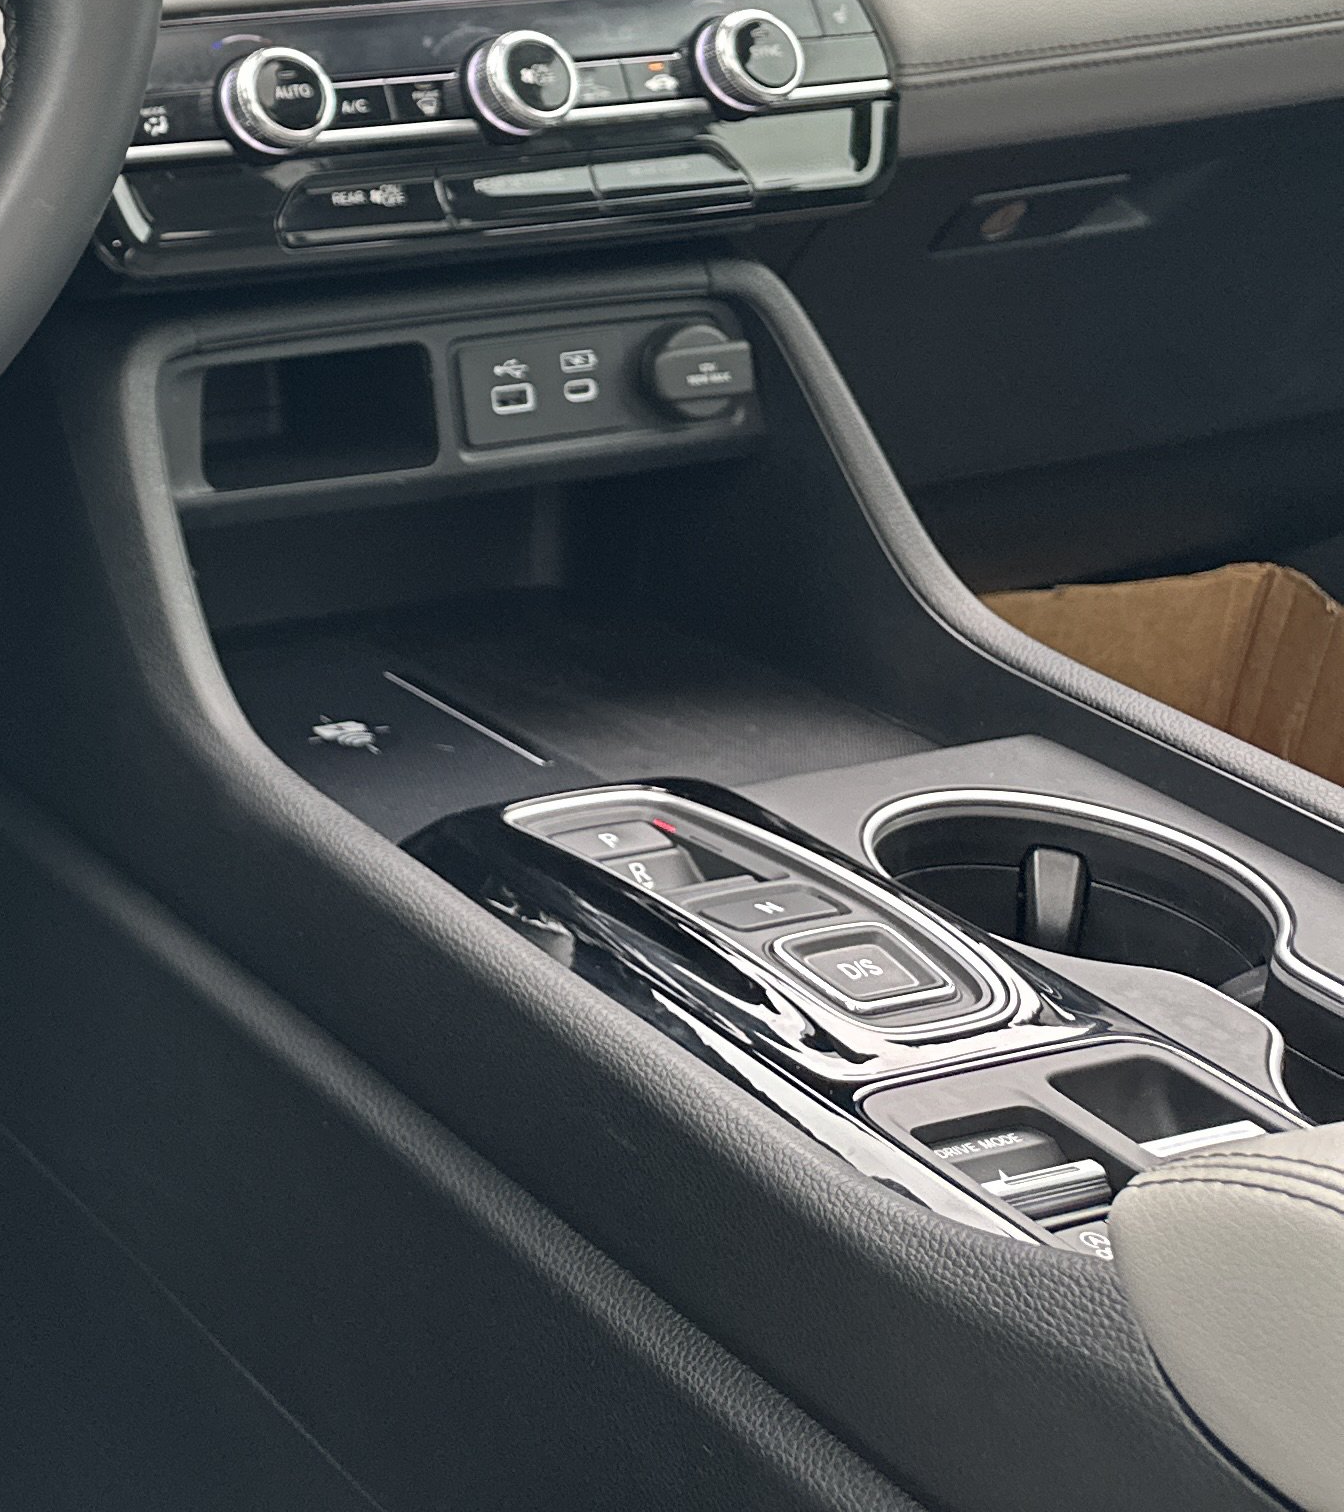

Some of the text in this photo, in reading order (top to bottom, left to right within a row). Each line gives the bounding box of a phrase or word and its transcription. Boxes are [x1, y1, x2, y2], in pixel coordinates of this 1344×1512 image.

[275, 83, 313, 100] AUTO
[341, 99, 371, 115] A/C
[332, 190, 367, 206] REAR
[598, 832, 620, 848] P
[628, 862, 654, 889] R
[753, 901, 785, 914] N
[837, 958, 884, 980] D/S
[934, 1133, 1023, 1160] DRIVE MODE
